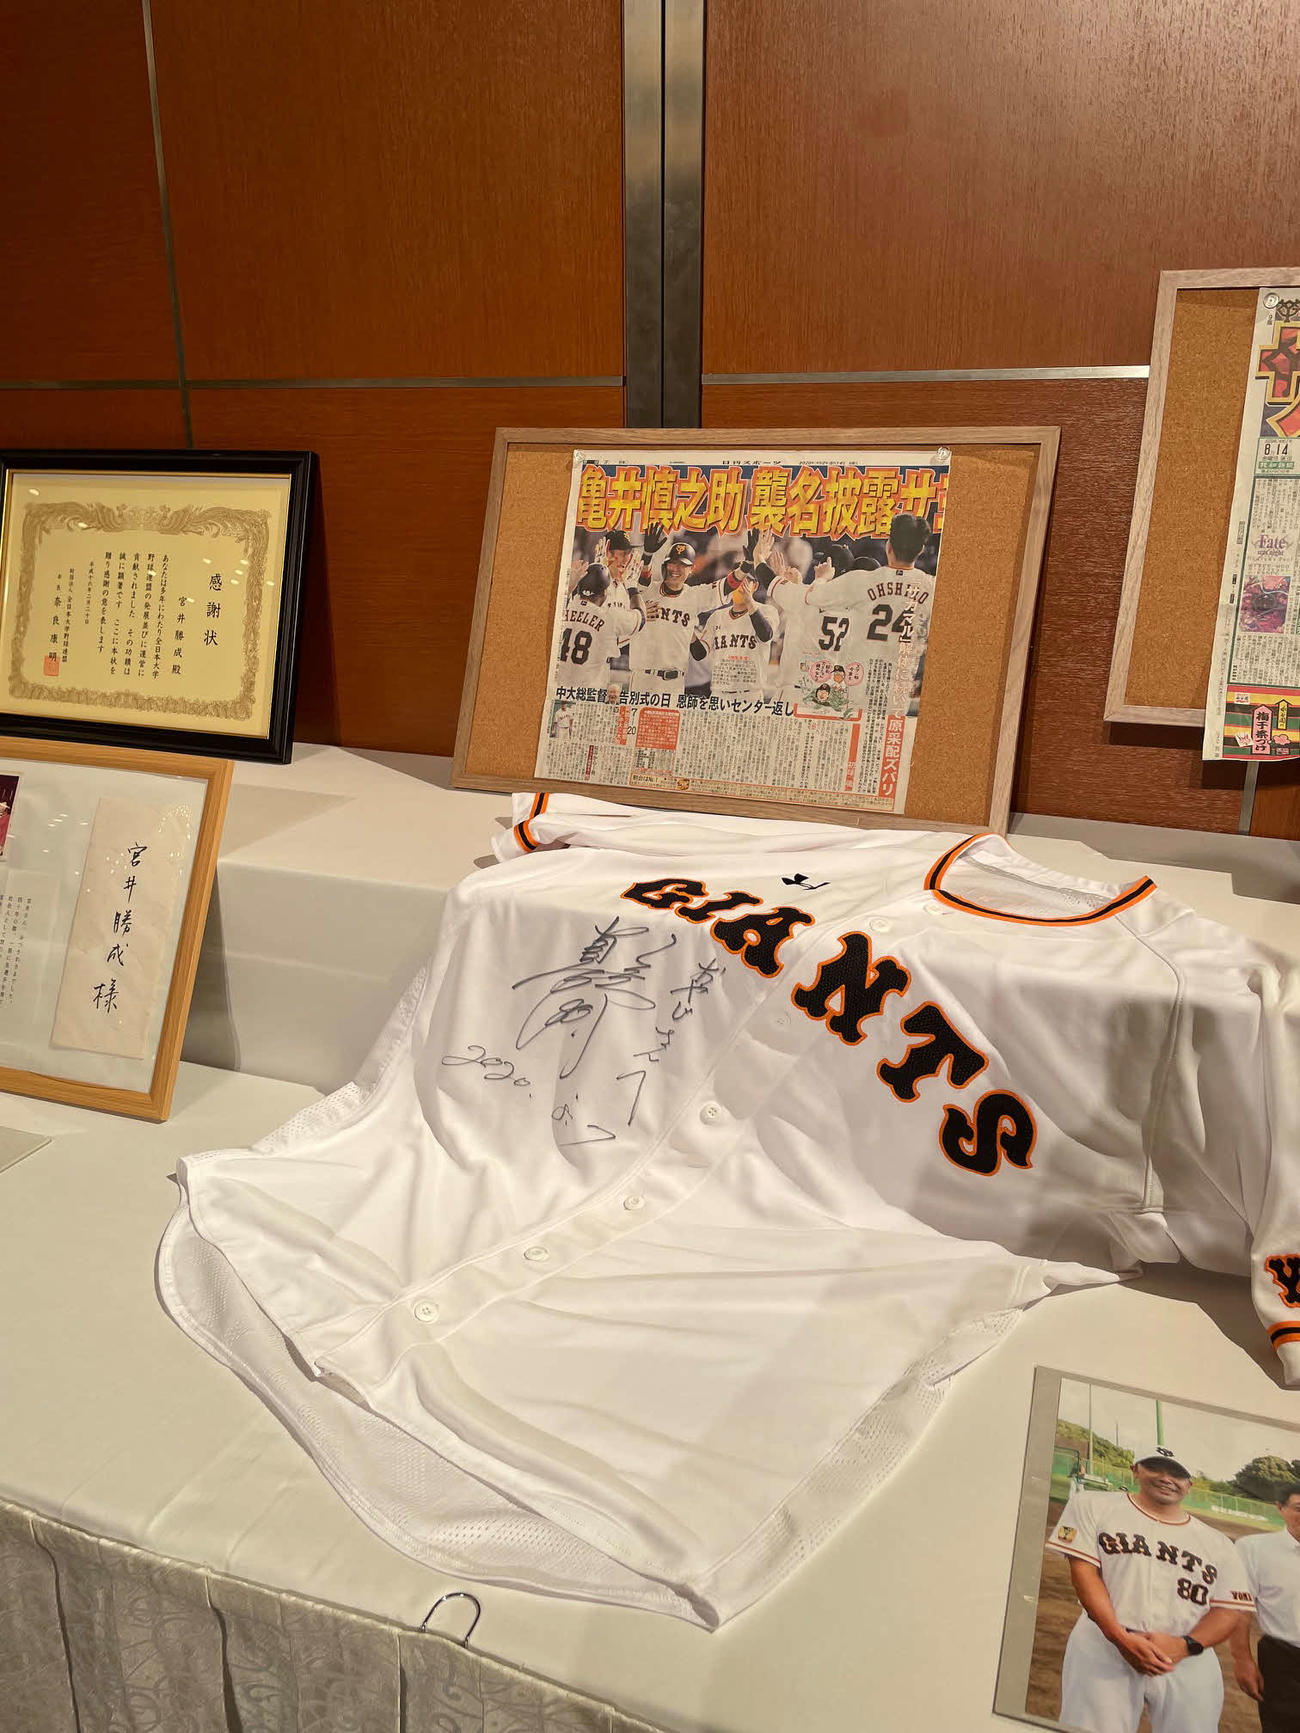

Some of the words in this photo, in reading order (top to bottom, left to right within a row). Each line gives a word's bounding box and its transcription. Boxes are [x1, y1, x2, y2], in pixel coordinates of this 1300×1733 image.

[751, 465, 950, 540] 襲名披露サ
[203, 573, 222, 646] 感謝状
[556, 685, 607, 703] 中大総監督
[676, 693, 795, 717] 恩師を思いセンター返し
[92, 841, 148, 1014] 宮井勝成様
[620, 877, 1038, 1177] GIANTS
[1098, 1531, 1218, 1585] GIANTS
[1176, 1576, 1209, 1606] 80
